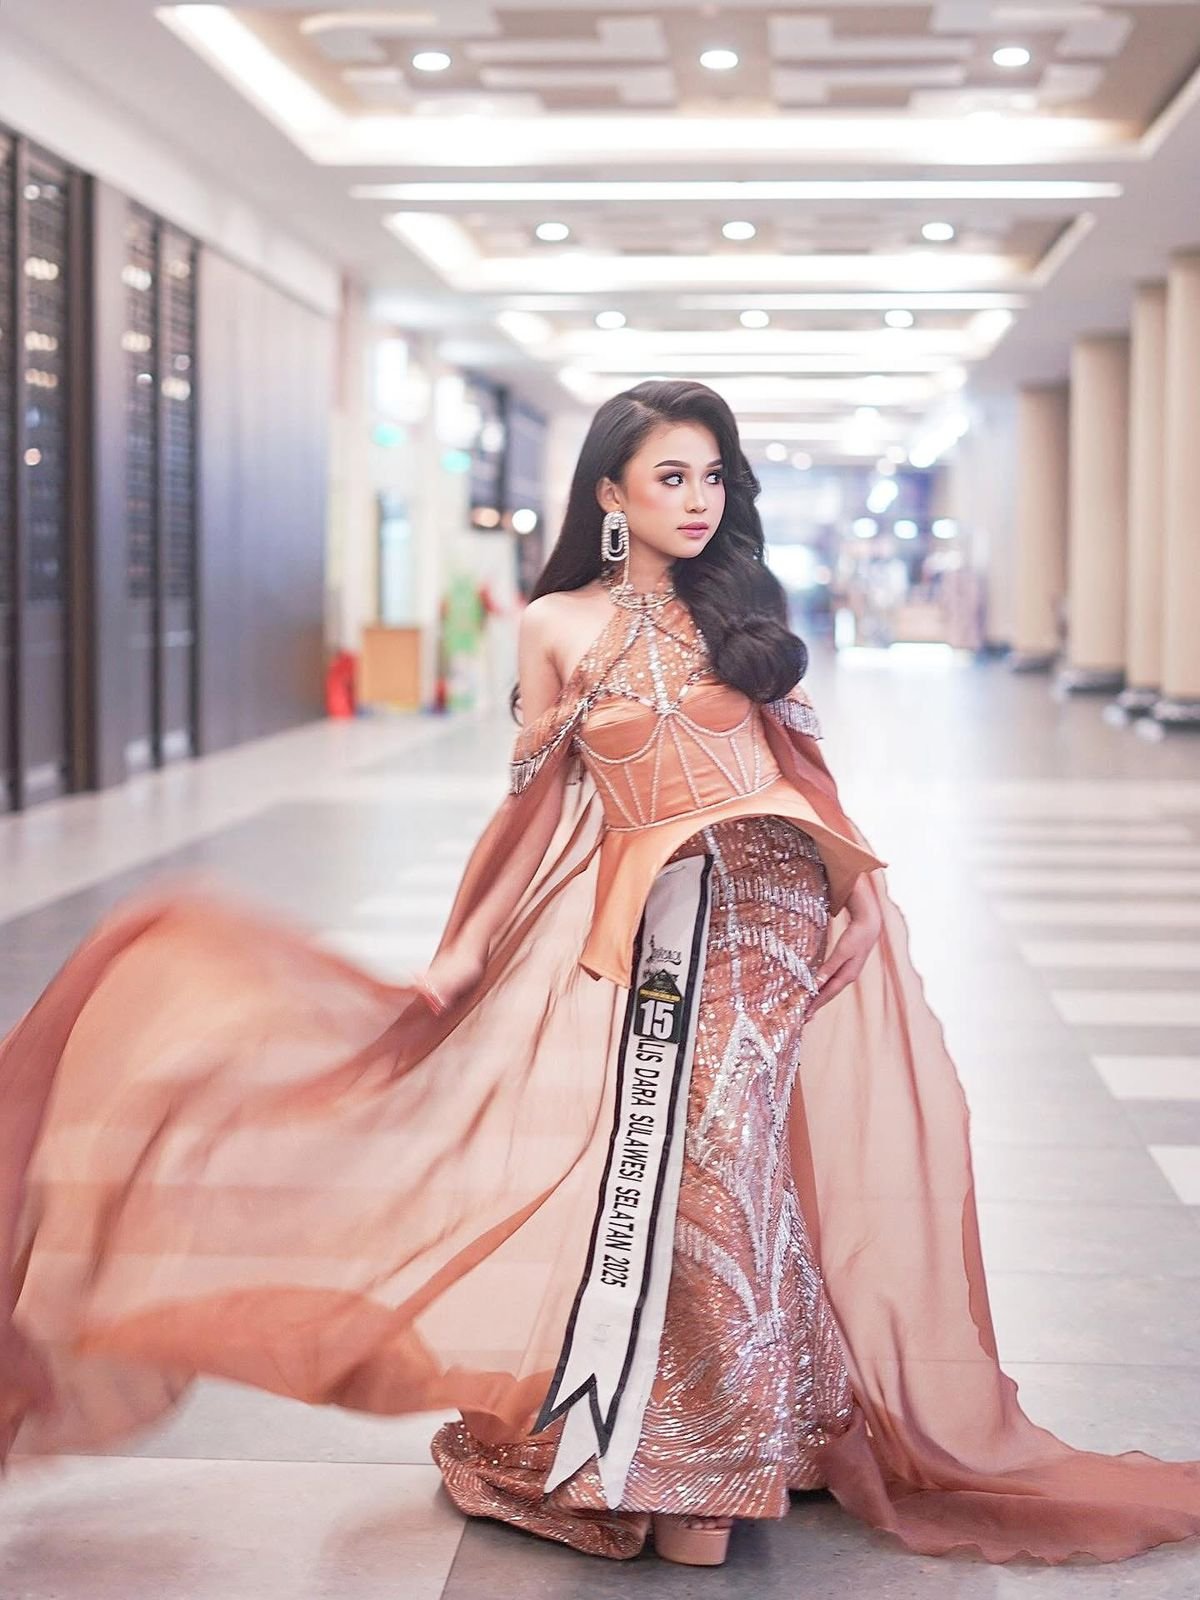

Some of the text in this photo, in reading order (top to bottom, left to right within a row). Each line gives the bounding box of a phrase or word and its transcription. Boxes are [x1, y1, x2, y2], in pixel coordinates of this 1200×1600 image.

[640, 1000, 674, 1040] 15
[635, 1036, 666, 1063] LIS
[631, 1067, 660, 1106] DARA
[617, 1113, 655, 1183] SULAWESI
[604, 1186, 641, 1252] SELATAN
[600, 1254, 631, 1288] 2025
